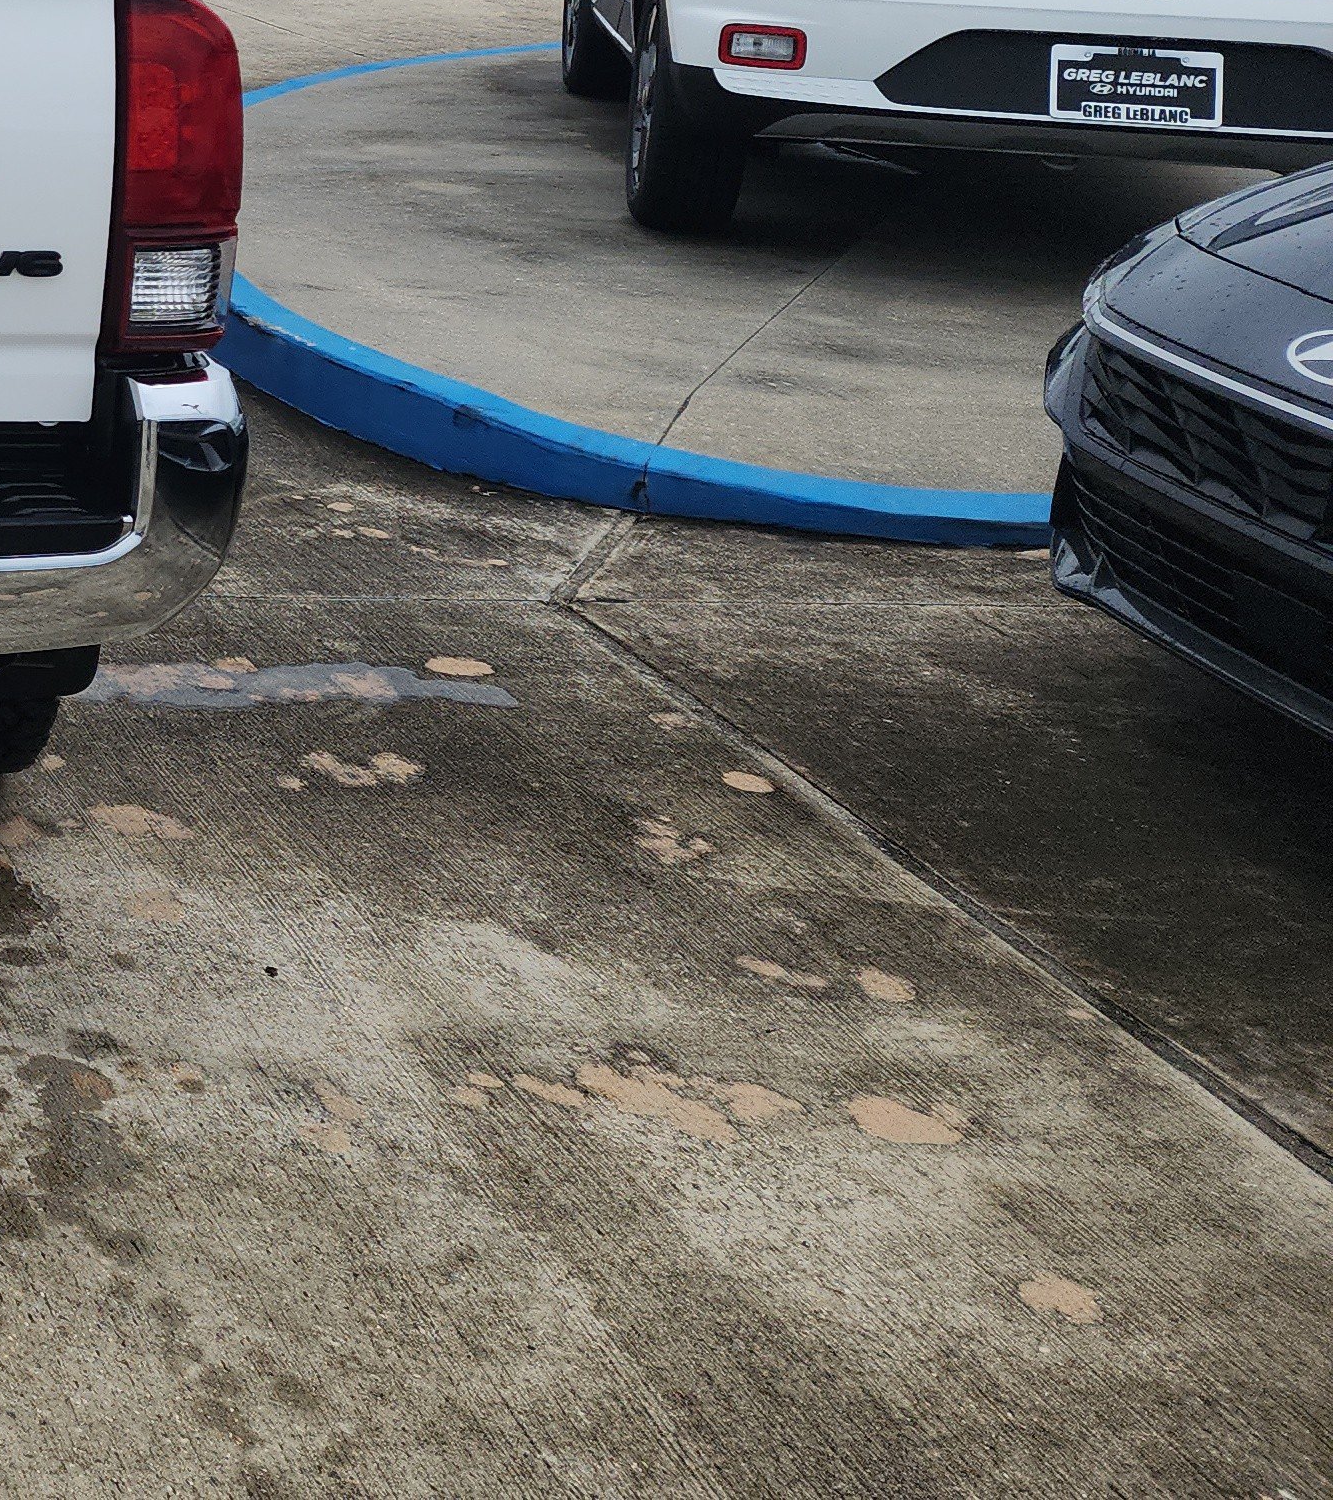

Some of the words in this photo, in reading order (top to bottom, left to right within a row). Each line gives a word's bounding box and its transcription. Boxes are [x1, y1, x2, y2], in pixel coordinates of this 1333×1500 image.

[1063, 67, 1115, 83] GREG
[1118, 70, 1208, 88] LEBLANC
[1116, 85, 1178, 98] HYUNDAI
[1083, 103, 1122, 120] GREG
